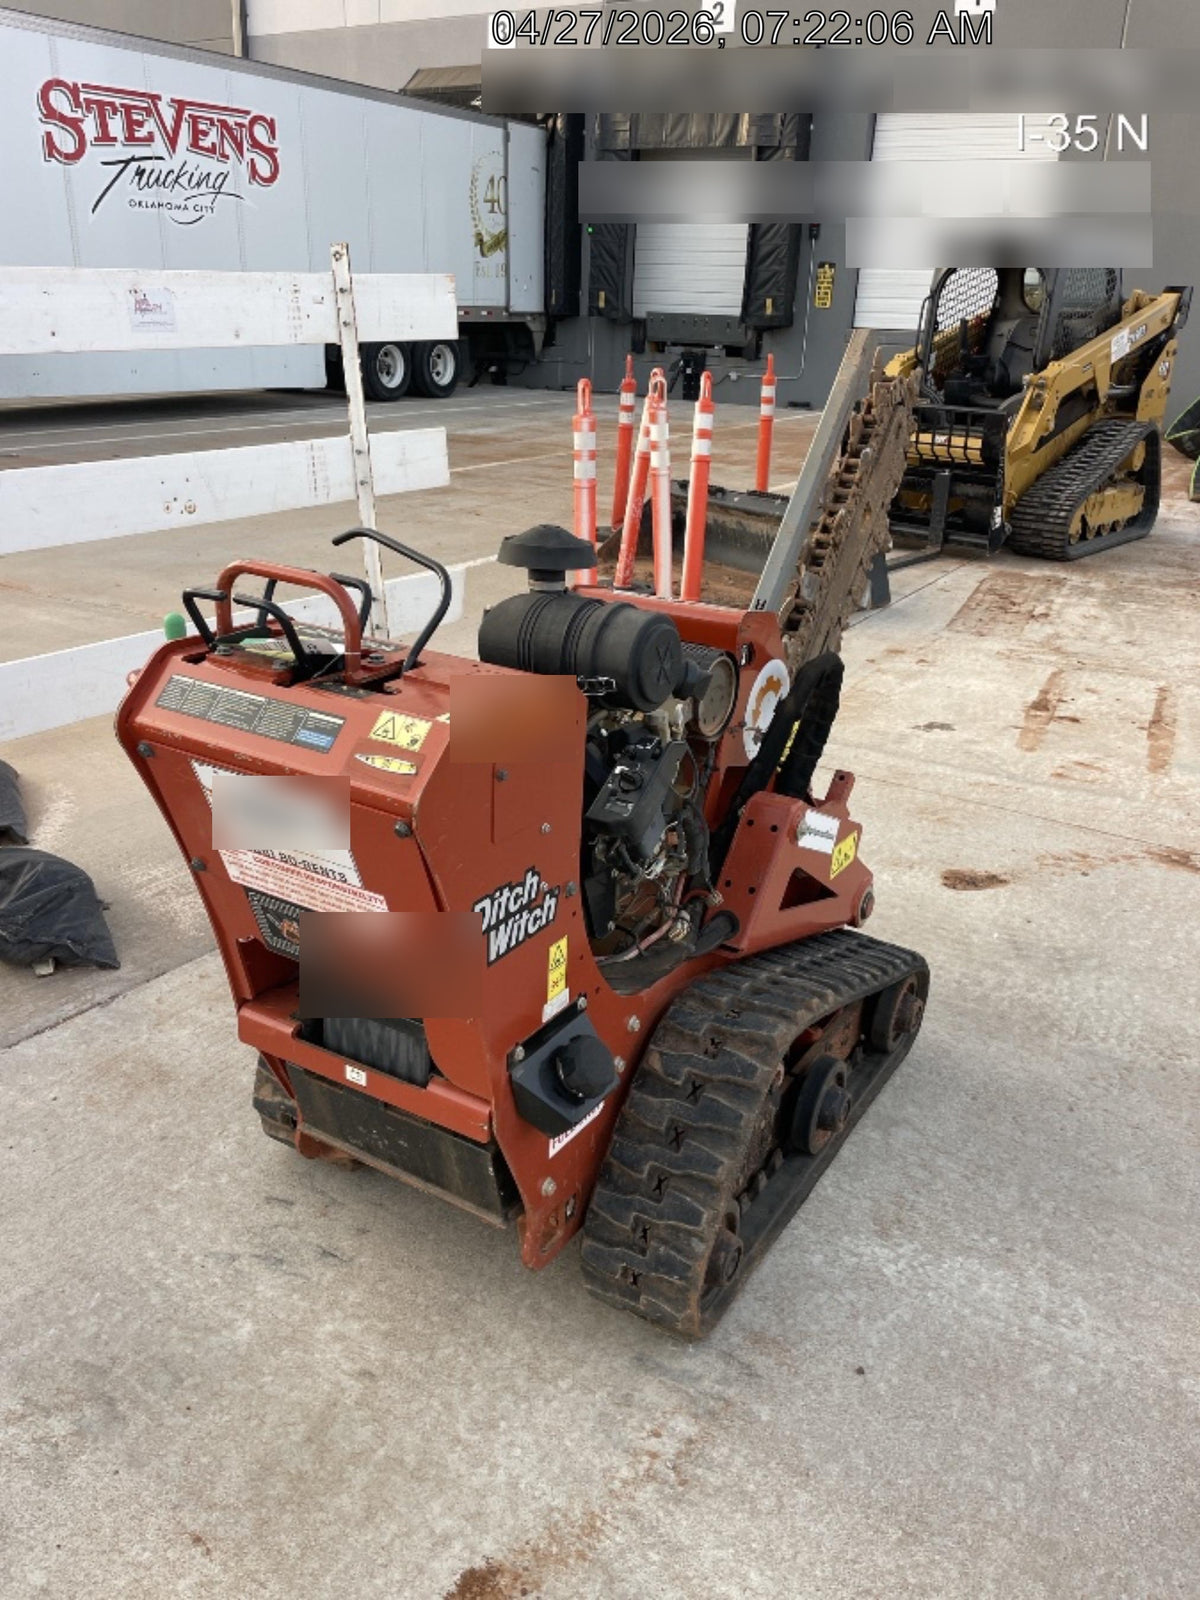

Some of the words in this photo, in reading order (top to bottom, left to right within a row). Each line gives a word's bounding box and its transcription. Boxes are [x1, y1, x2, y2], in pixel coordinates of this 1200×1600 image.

[712, 1, 725, 26] 2
[38, 78, 279, 187] STEVENS
[91, 154, 230, 214] Trucking
[193, 202, 216, 214] CITY
[488, 887, 559, 964] Witch
